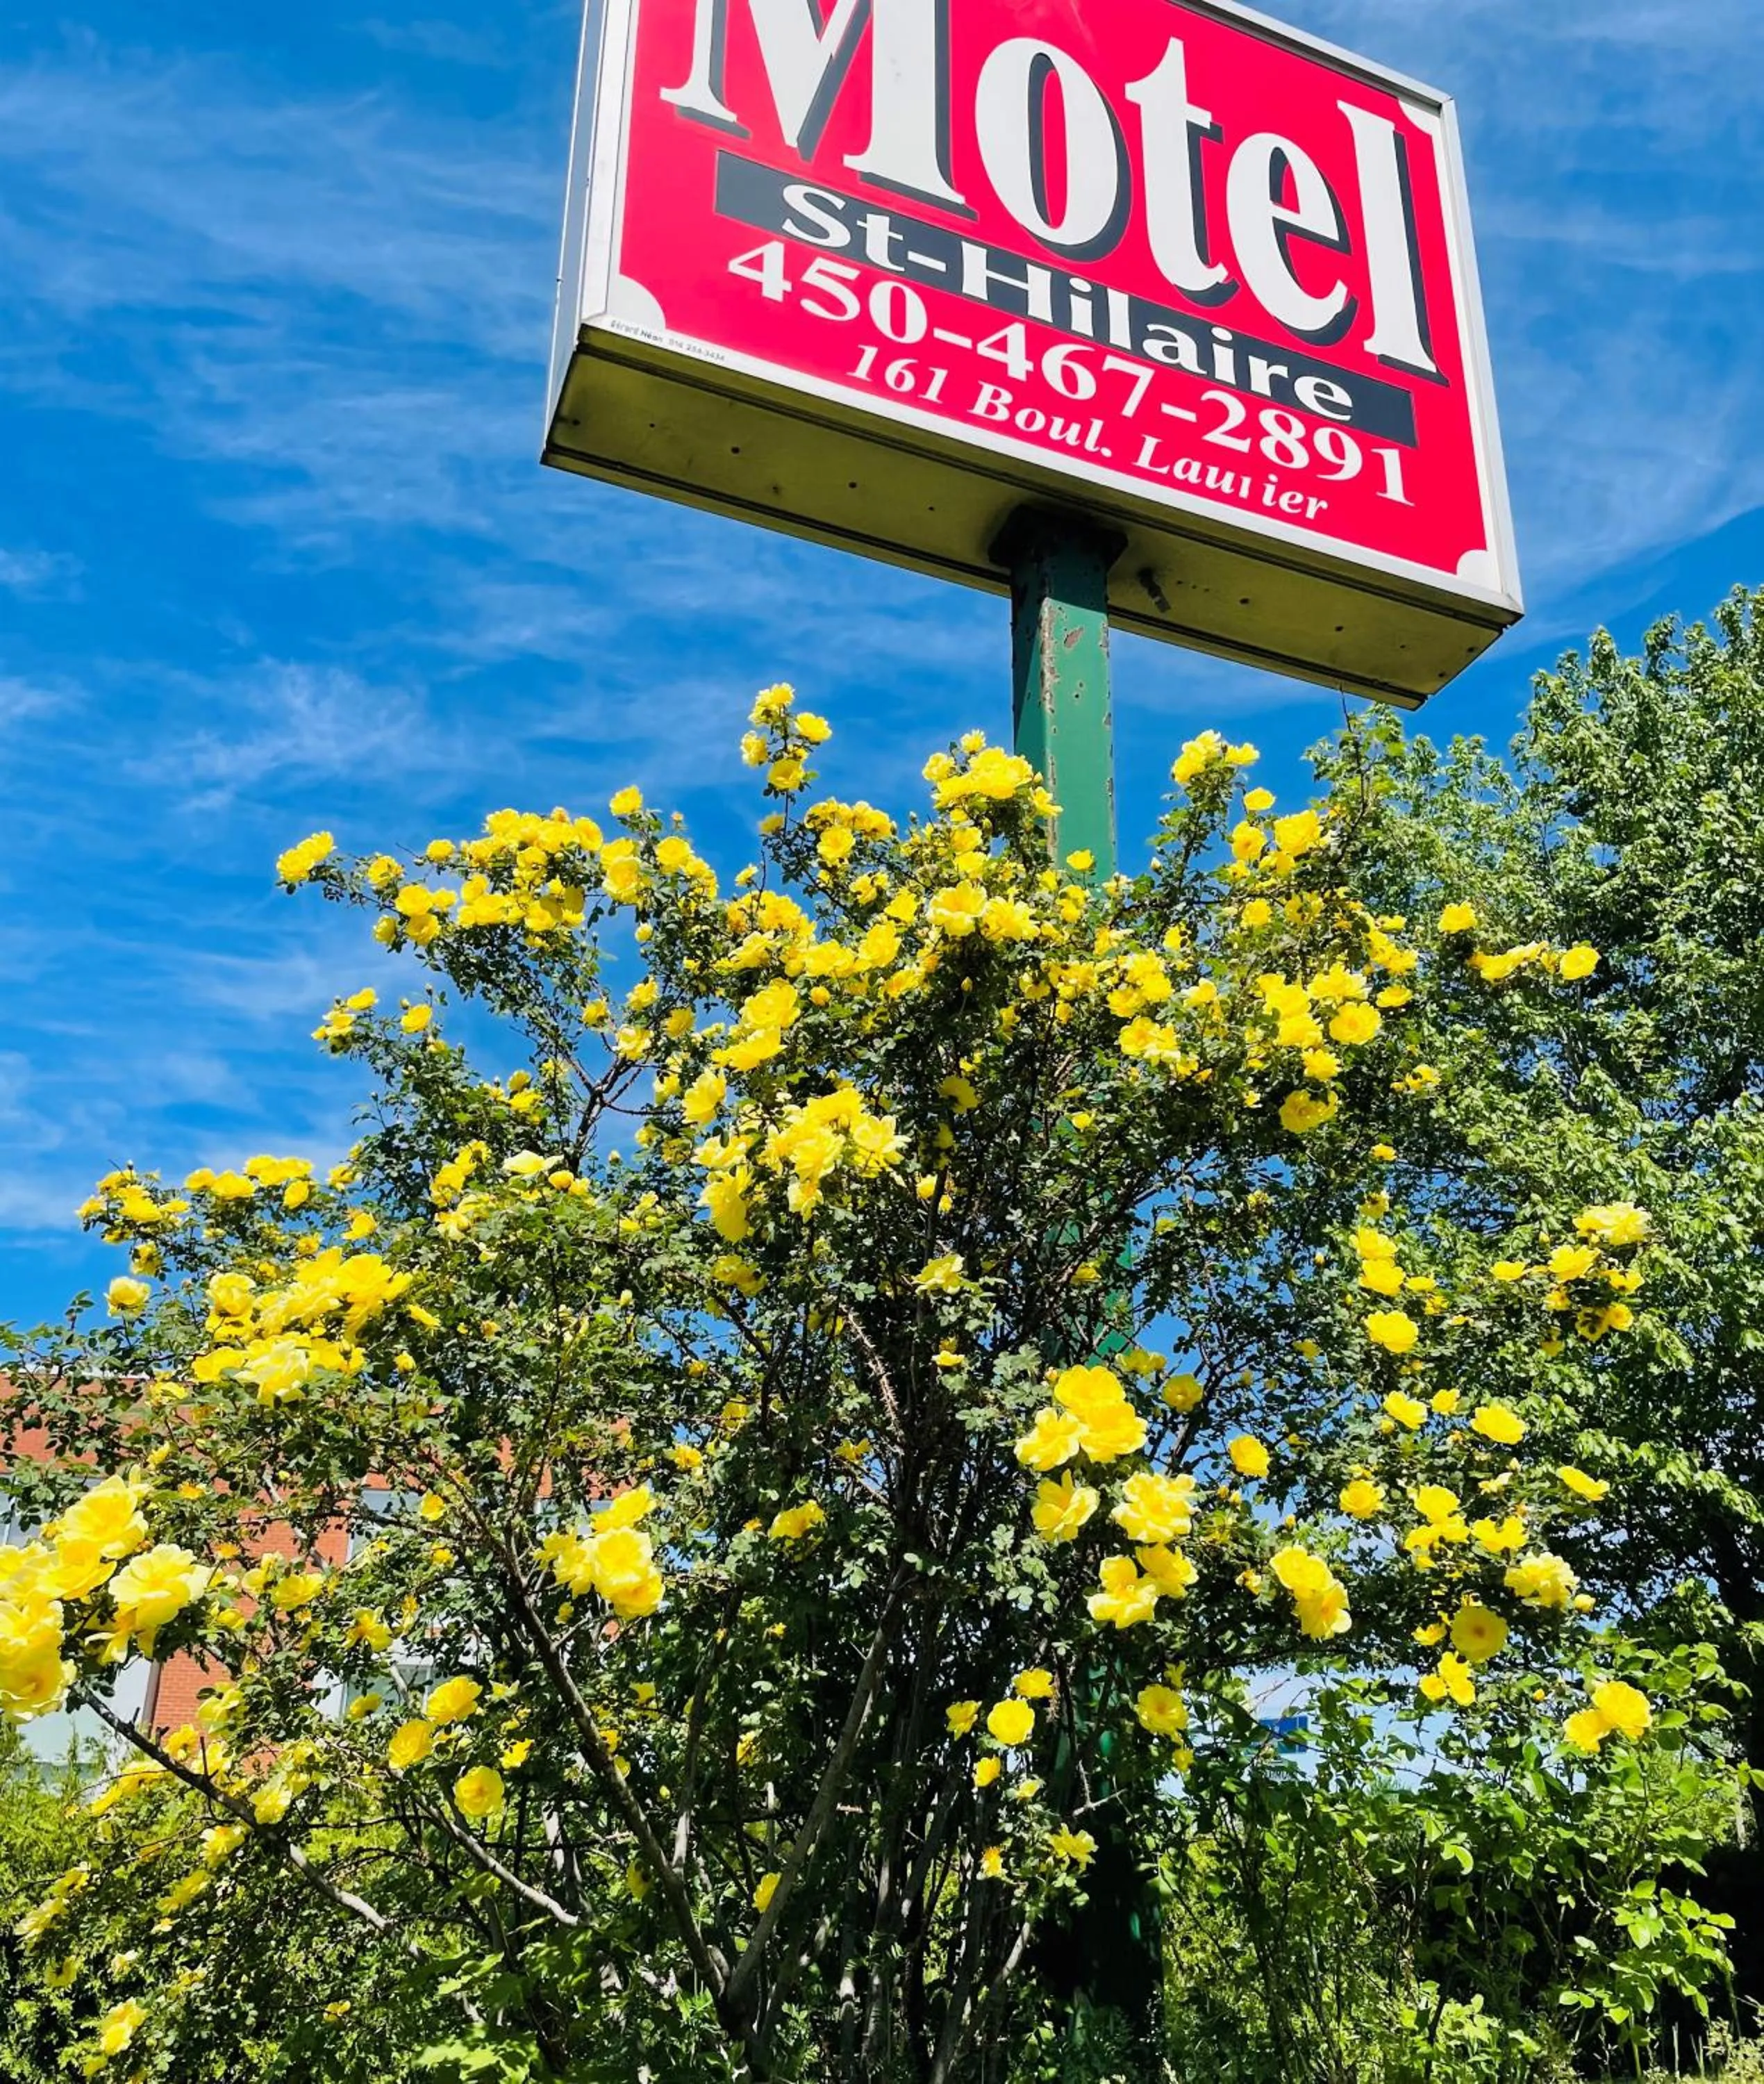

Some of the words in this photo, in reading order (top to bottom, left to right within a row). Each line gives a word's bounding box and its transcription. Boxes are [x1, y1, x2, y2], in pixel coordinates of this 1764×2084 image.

[660, 0, 1440, 377] Motel
[781, 184, 1354, 421] St-Hilaire
[728, 240, 1413, 506] 450-467-2891
[850, 345, 947, 403] 161
[970, 382, 1113, 458] Boul.
